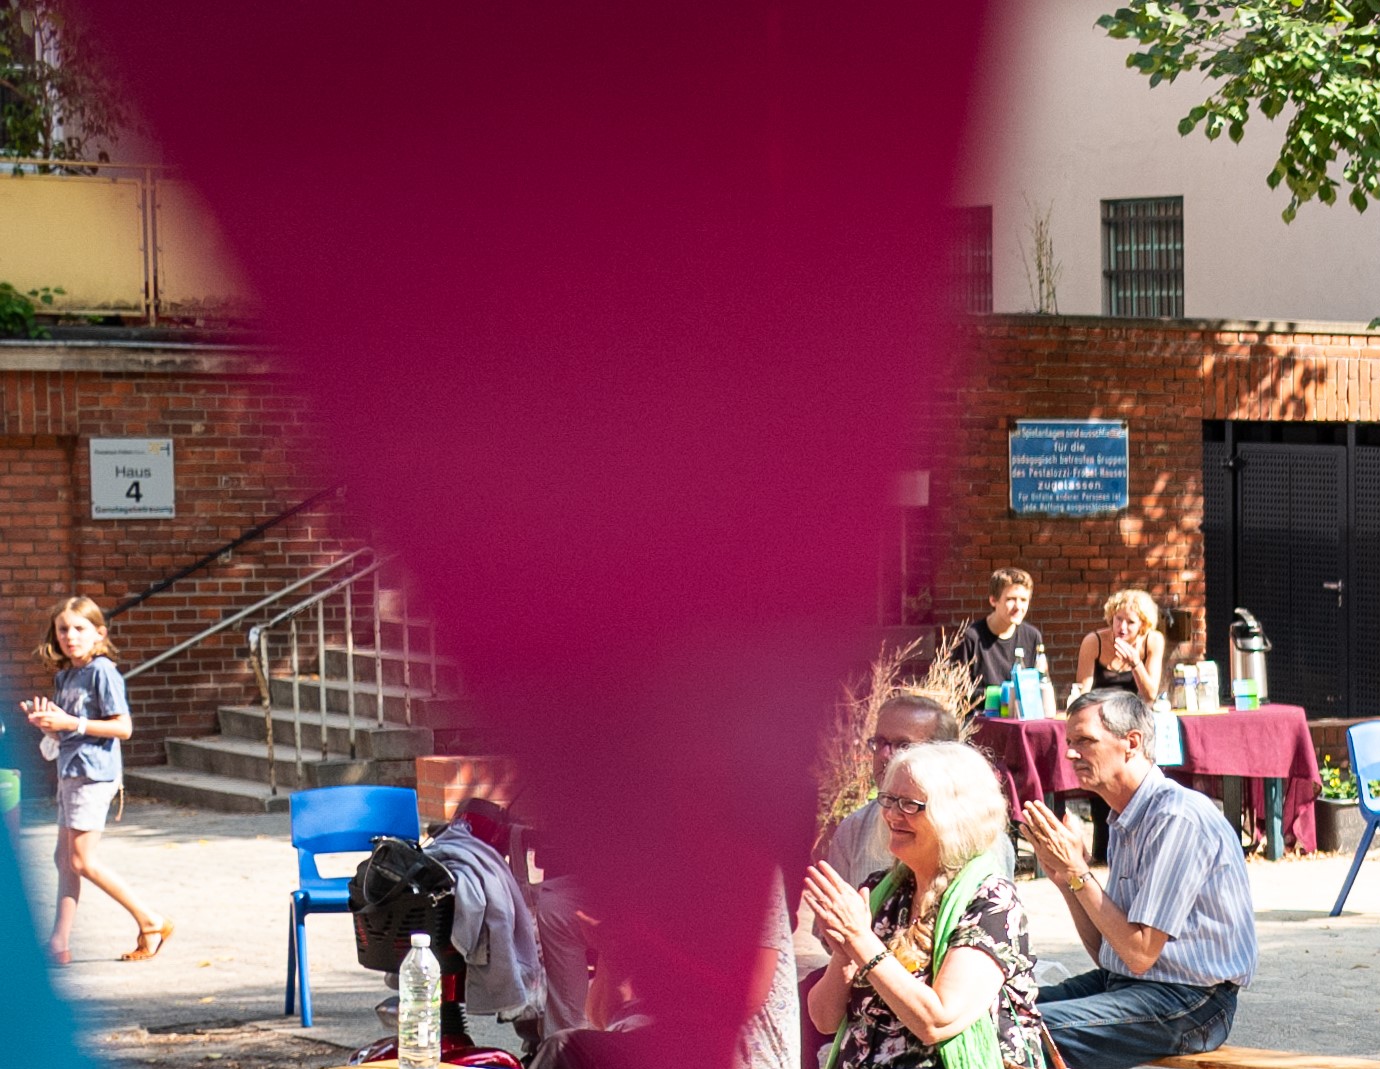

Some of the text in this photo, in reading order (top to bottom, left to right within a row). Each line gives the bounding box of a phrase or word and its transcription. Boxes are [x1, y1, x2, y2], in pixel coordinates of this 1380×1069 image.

[1054, 441, 1085, 452] für die
[115, 465, 151, 478] Haus
[1012, 466, 1026, 478] des
[125, 480, 143, 503] 4
